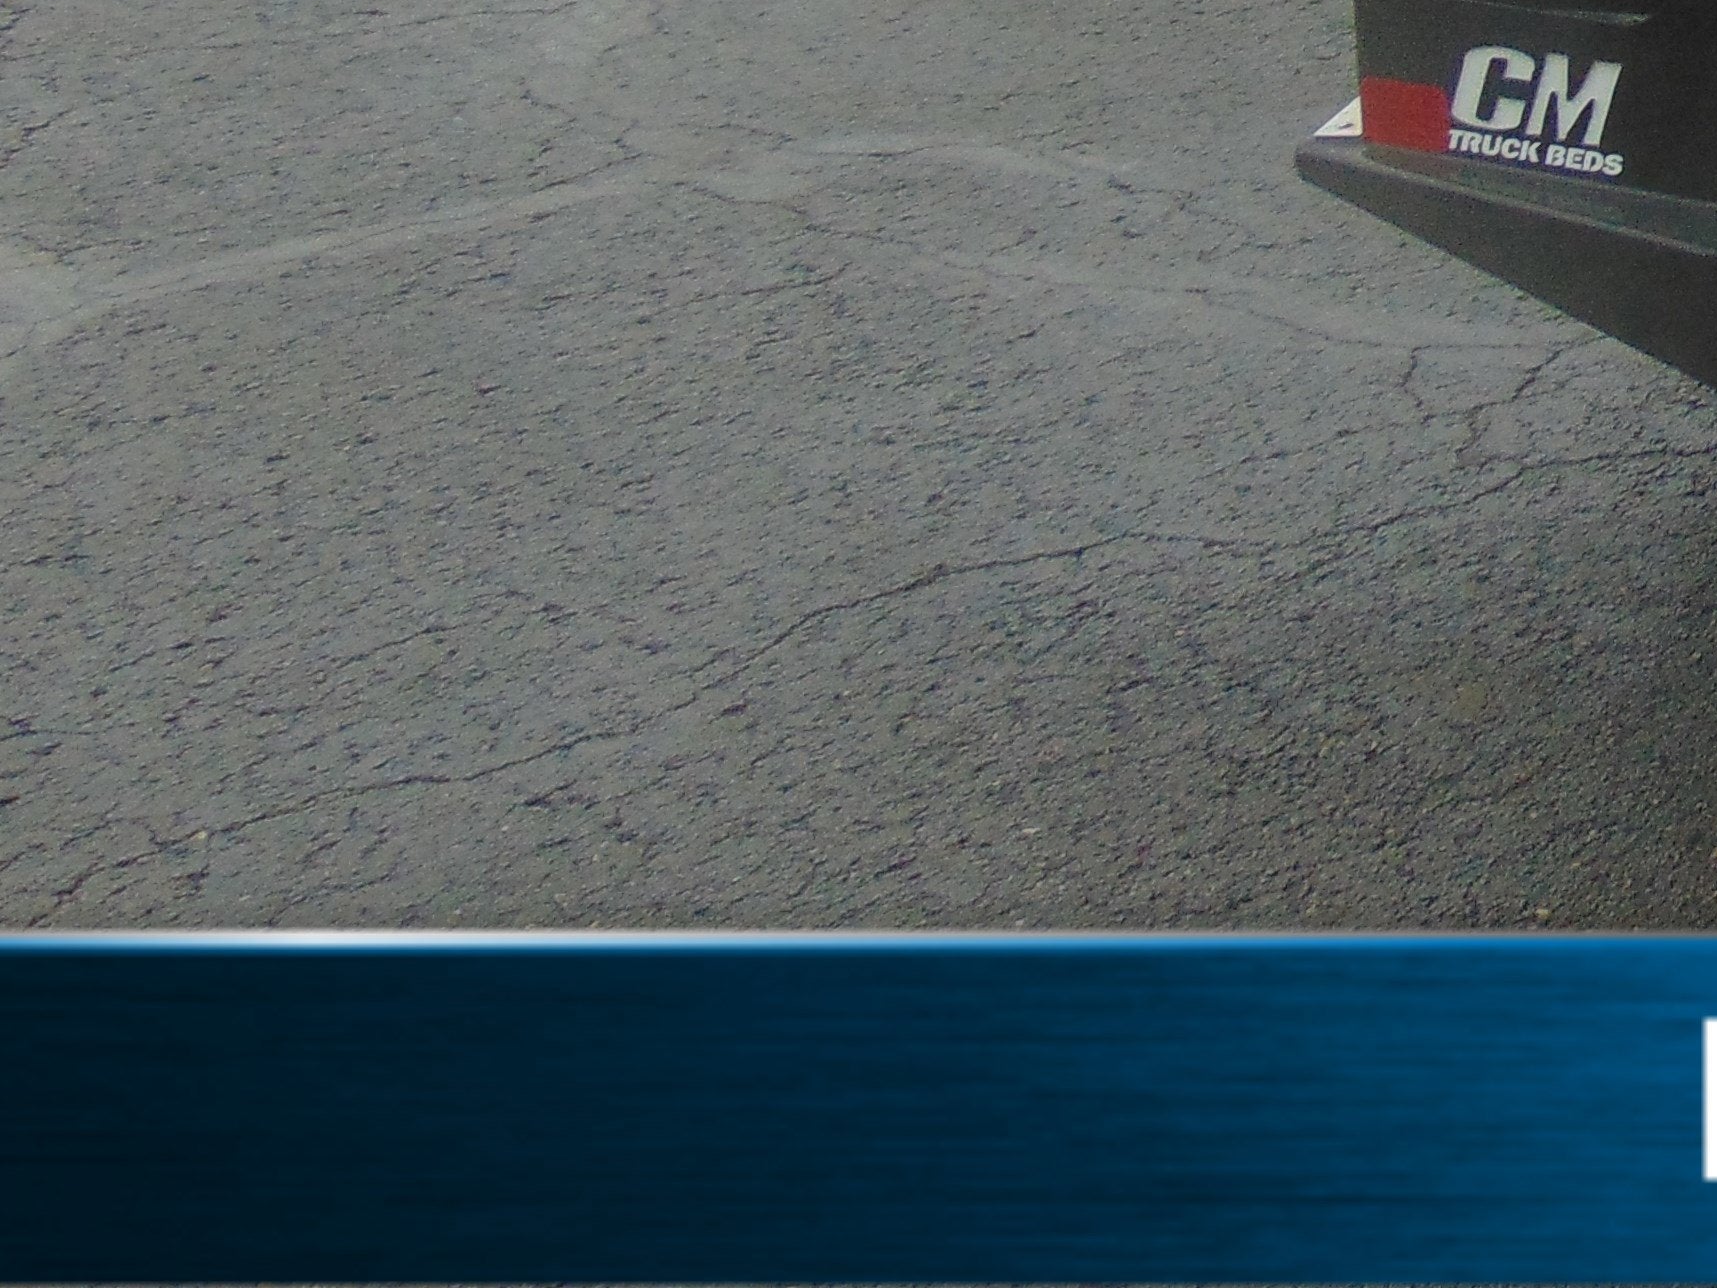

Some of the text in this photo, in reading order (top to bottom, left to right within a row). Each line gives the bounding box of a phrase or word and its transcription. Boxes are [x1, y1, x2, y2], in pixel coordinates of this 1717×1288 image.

[1450, 43, 1624, 146] CM
[1447, 128, 1625, 177] TRUCK BEDS
